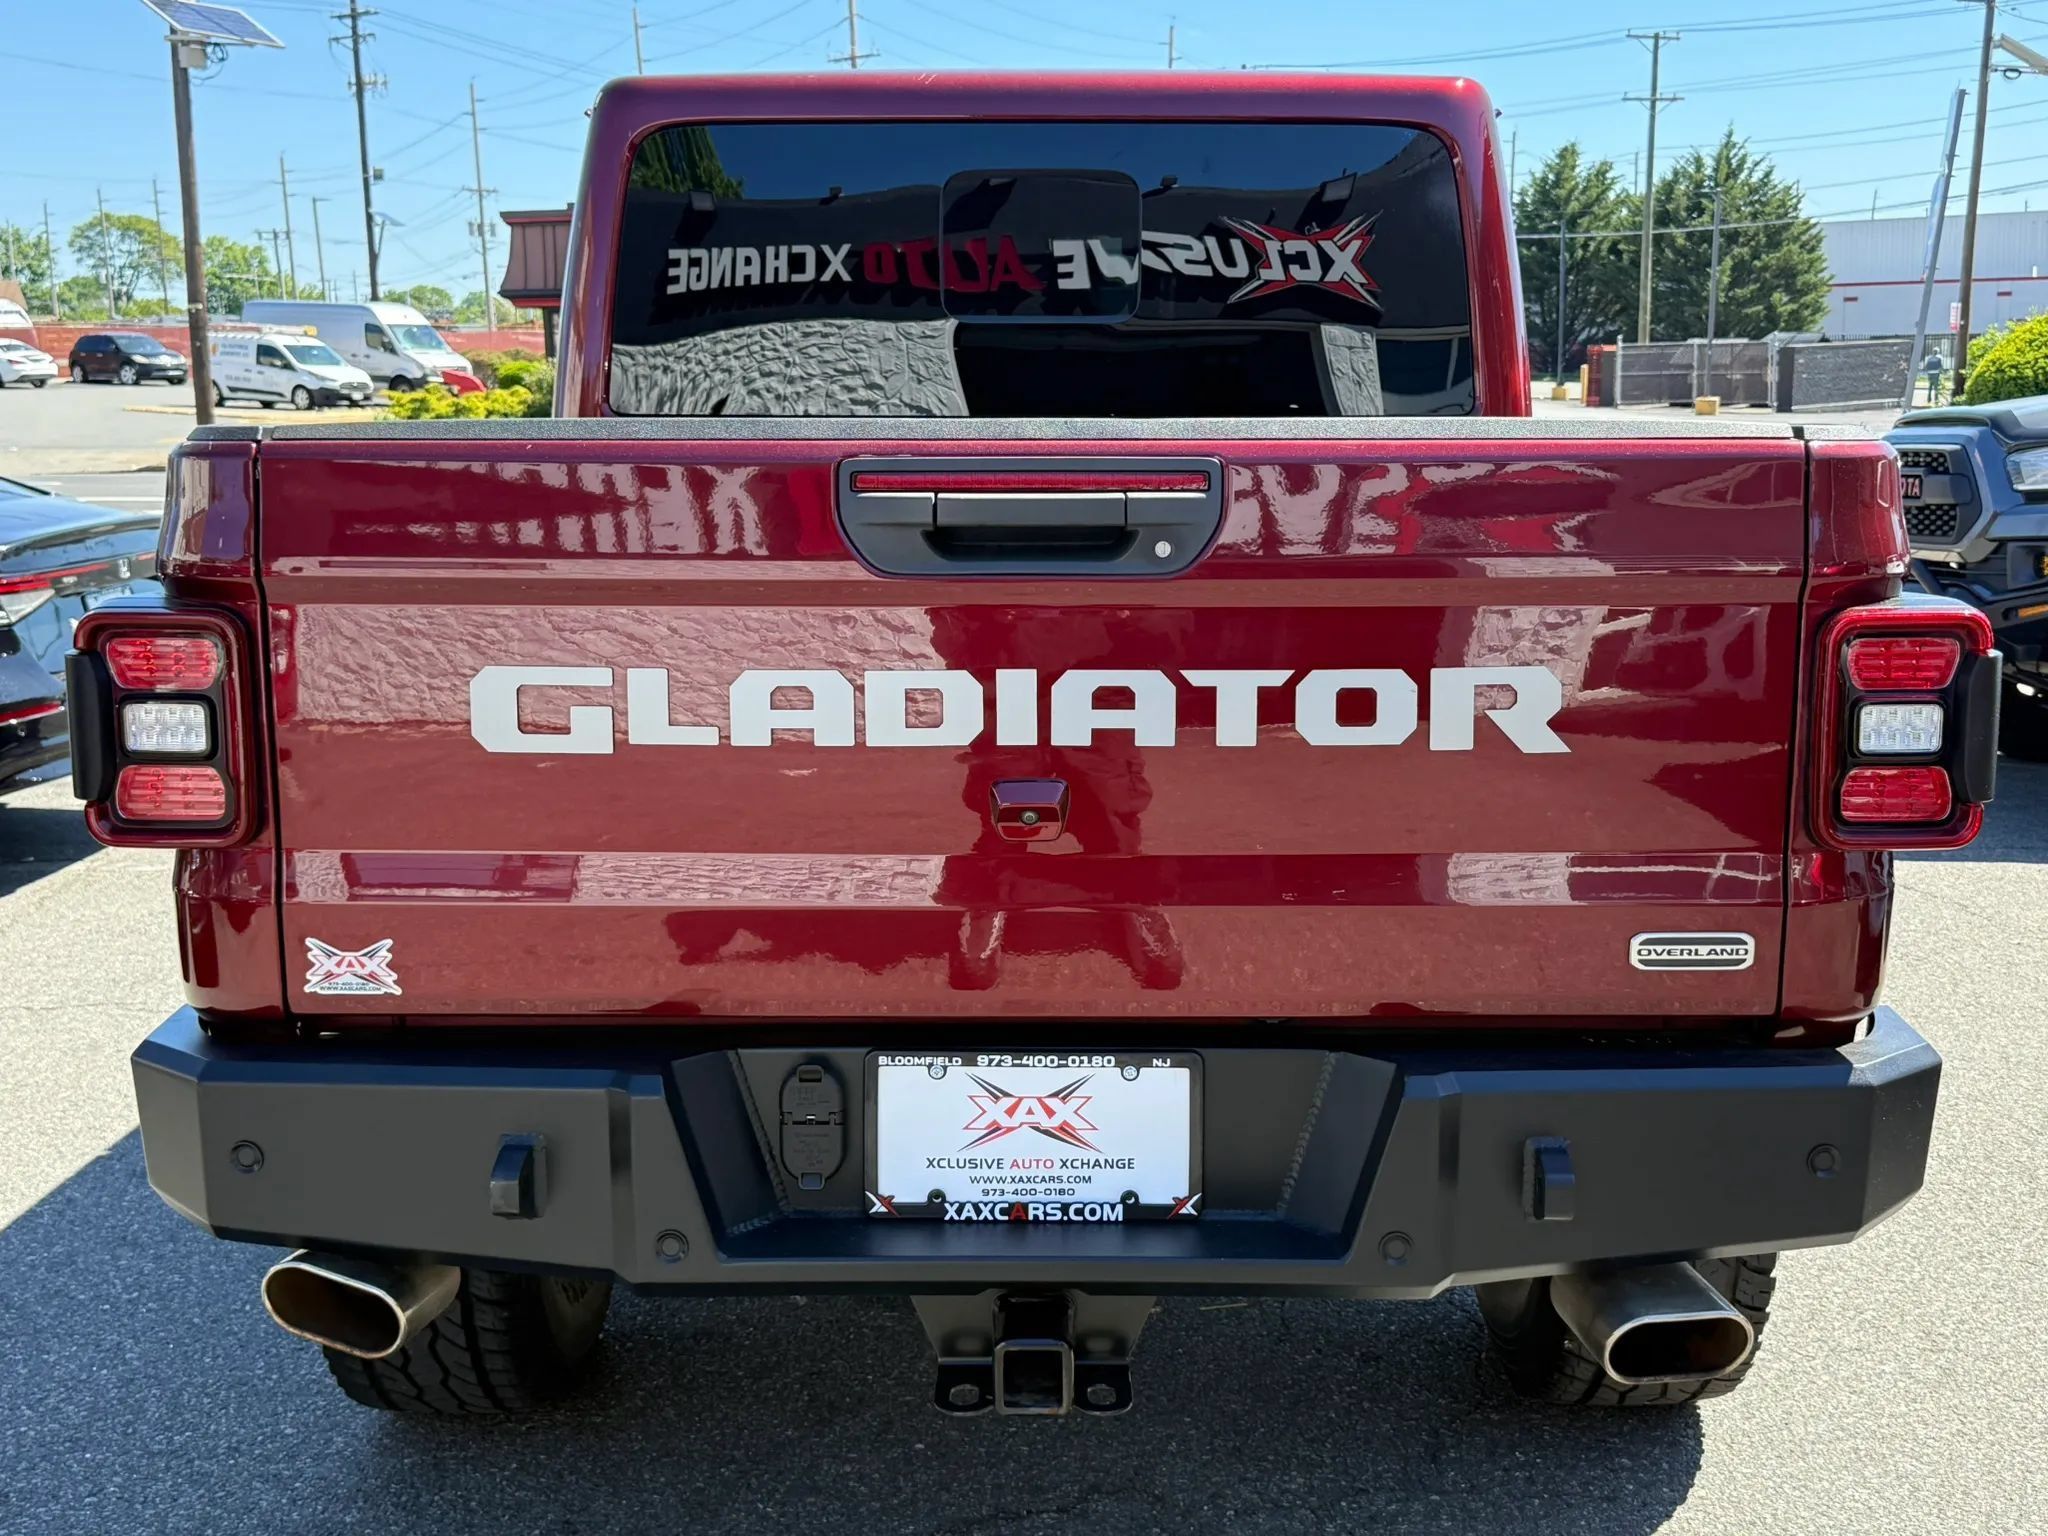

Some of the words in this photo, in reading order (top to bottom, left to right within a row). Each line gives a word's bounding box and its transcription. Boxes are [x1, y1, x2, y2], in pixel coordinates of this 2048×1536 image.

[470, 665, 1570, 755] GLADIATOR
[1636, 947, 1749, 957] OVERLAND
[877, 1055, 962, 1067] BLOOMFIELD
[976, 1055, 1116, 1067] 973-400-0180
[1152, 1057, 1171, 1067] NJ
[963, 1095, 1099, 1131] XAX
[926, 1157, 1005, 1170] XCLUSIVE
[1009, 1157, 1055, 1170] AUTO
[1059, 1157, 1136, 1170] XCHANGE
[969, 1174, 1092, 1185] WWW.XAXCARS.COM
[981, 1188, 1076, 1197] 973-400-0180
[943, 1202, 1124, 1222] XAXCARS.COM
